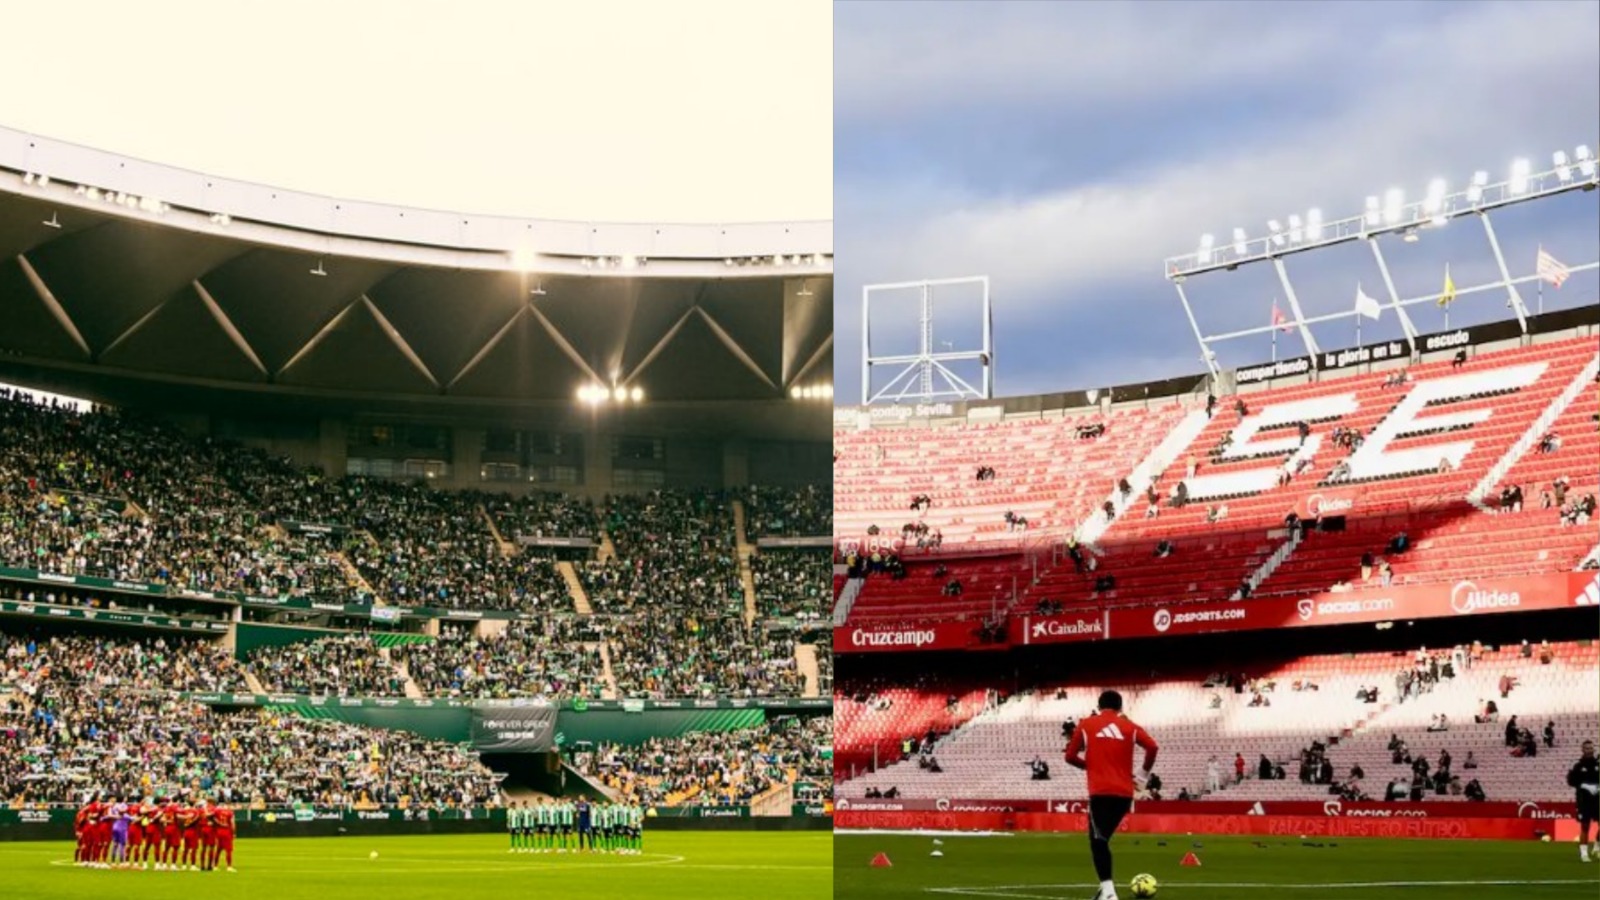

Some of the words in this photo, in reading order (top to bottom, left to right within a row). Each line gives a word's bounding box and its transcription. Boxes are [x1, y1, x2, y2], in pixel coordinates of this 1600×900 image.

[1236, 358, 1308, 381] compartiendo
[1325, 353, 1336, 366] la
[1338, 348, 1370, 368] gloria
[1373, 346, 1388, 358] en
[1390, 343, 1402, 355] tu
[1427, 329, 1470, 350] escudo
[916, 403, 953, 417] Sevilla
[1451, 580, 1521, 615] Midea
[1173, 608, 1246, 624] JDSPORTS.COM
[1047, 618, 1103, 636] CaixaBank
[852, 628, 935, 647] Cruzcampo
